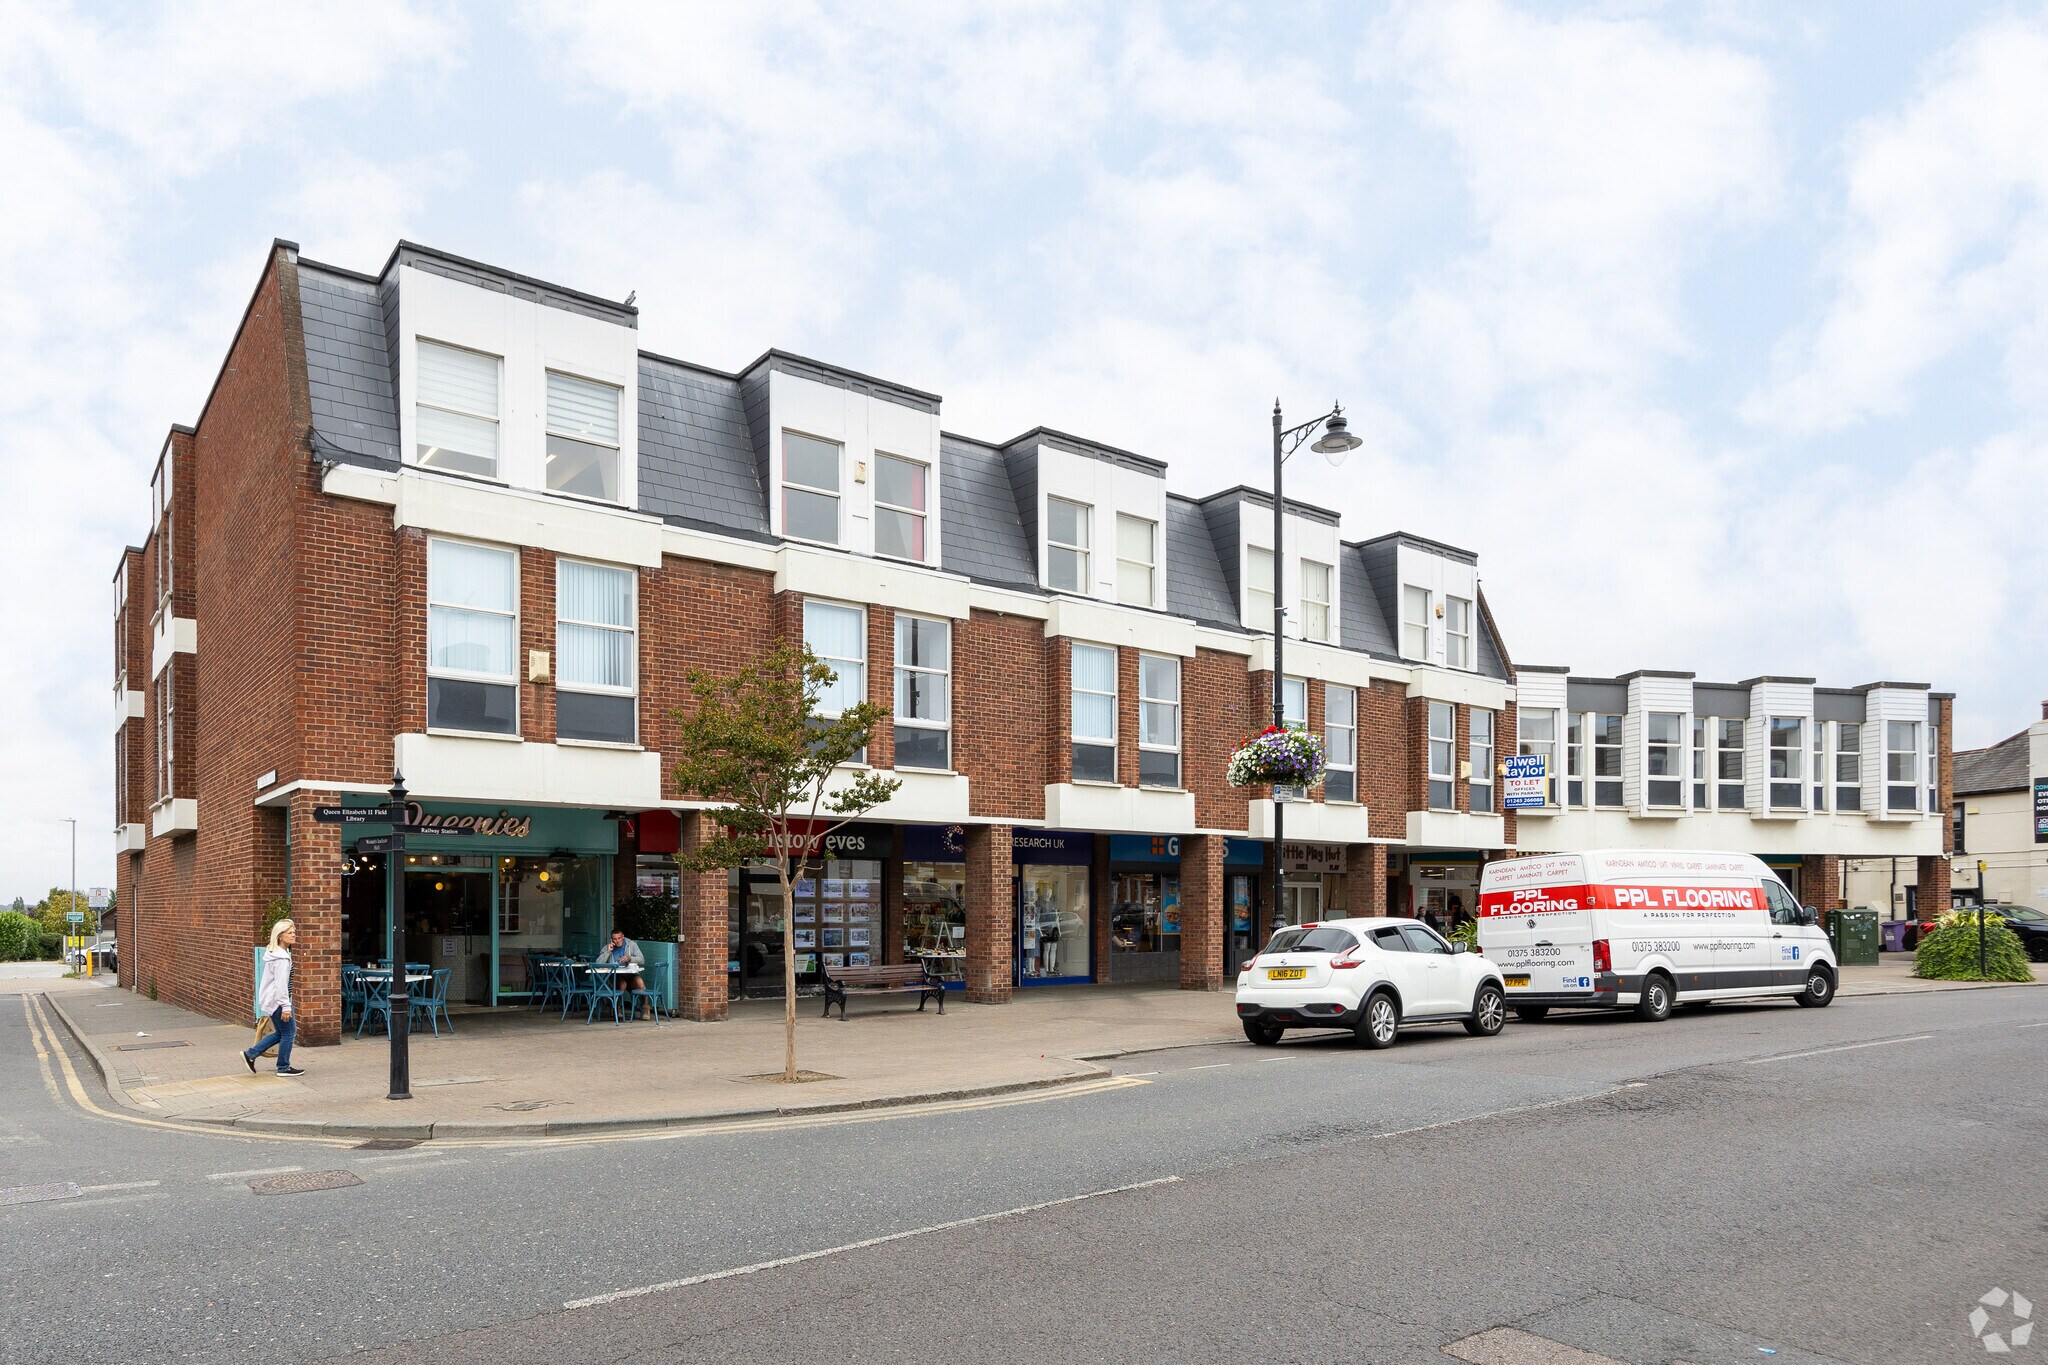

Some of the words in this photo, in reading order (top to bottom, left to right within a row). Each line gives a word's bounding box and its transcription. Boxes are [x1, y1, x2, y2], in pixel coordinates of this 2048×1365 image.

[1506, 755, 1544, 766] elwell
[1506, 766, 1544, 778] taylor
[396, 802, 531, 838] Queenies
[737, 829, 820, 849] airstow
[826, 835, 865, 850] eves
[1011, 838, 1051, 848] RESEARCH
[1053, 839, 1064, 848] UK
[1283, 845, 1304, 860] ittle
[1306, 845, 1323, 862] Play
[1326, 846, 1341, 862] Hut
[1671, 861, 1684, 870] VINYL
[1513, 889, 1549, 901] PPL
[1614, 888, 1658, 906] PPL
[1662, 889, 1754, 908] FLOORING
[1490, 898, 1578, 916] FLOORING
[1632, 942, 1652, 952] 01375
[1654, 941, 1680, 952] 383200
[1693, 940, 1756, 952] www.pplflooring.com
[1531, 948, 1560, 957] 383200
[1497, 959, 1575, 968] www.pplflooring.com
